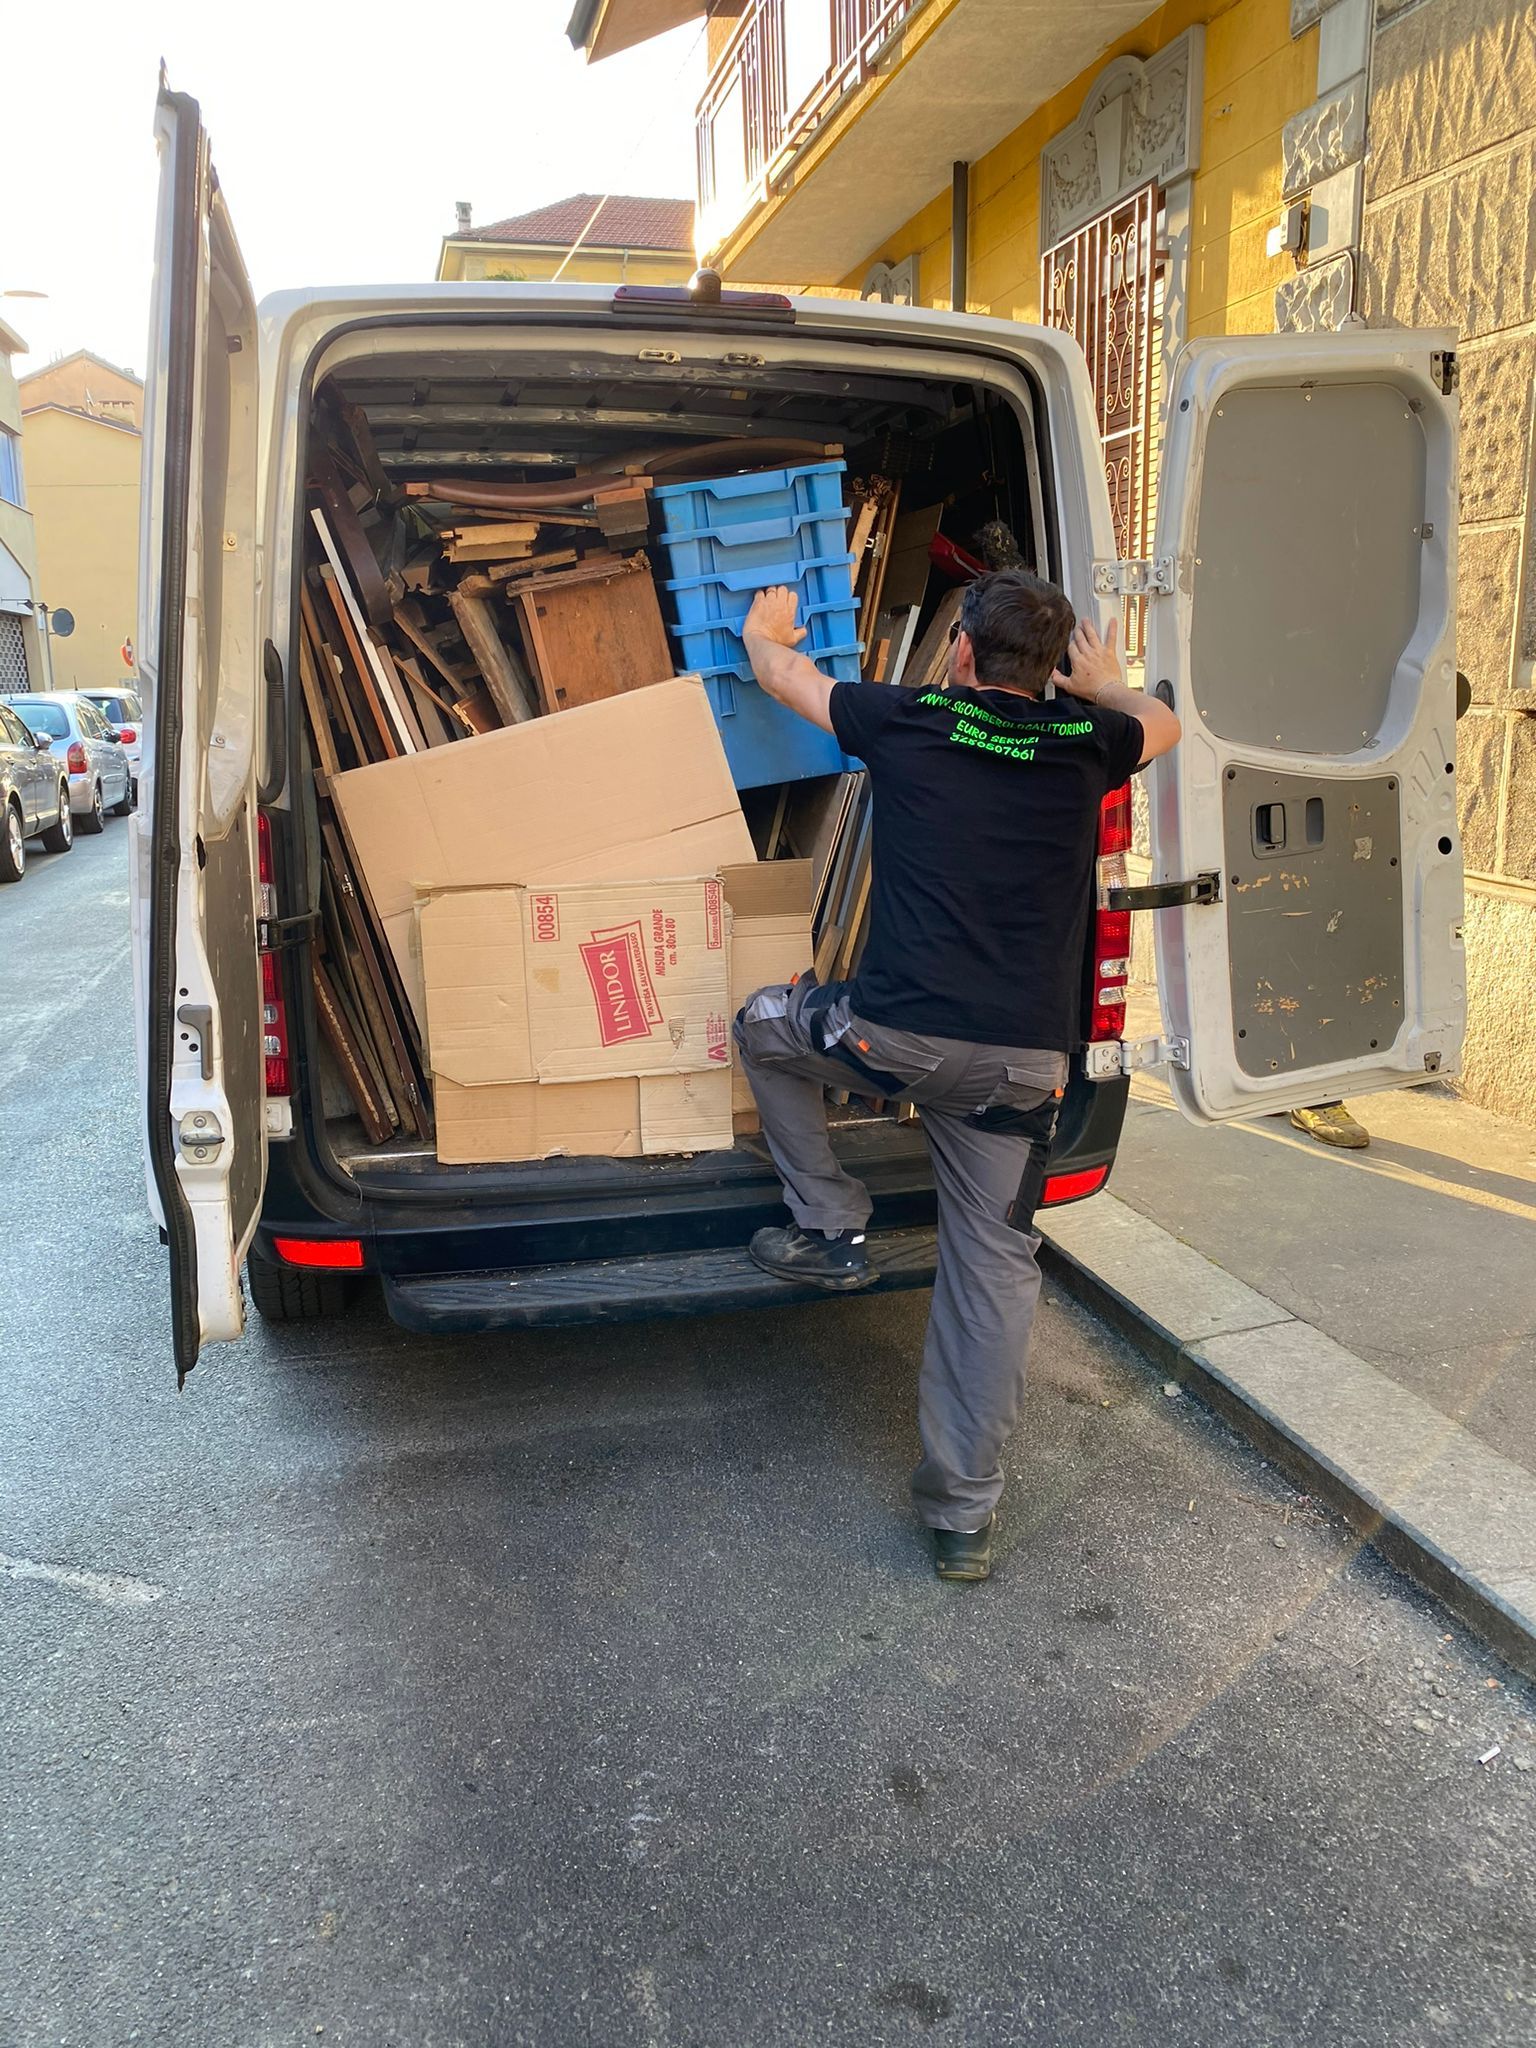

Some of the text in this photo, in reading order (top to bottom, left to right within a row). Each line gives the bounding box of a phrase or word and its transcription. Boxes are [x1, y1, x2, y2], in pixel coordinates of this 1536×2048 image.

[956, 720, 1040, 746] EURO SERVIZI
[536, 896, 556, 940] 00854
[653, 909, 666, 976] MISURA GRANDE
[665, 918, 677, 965] cm. 80x180
[600, 949, 633, 1032] LINIDOR
[642, 987, 654, 1018] TRAVERSA
